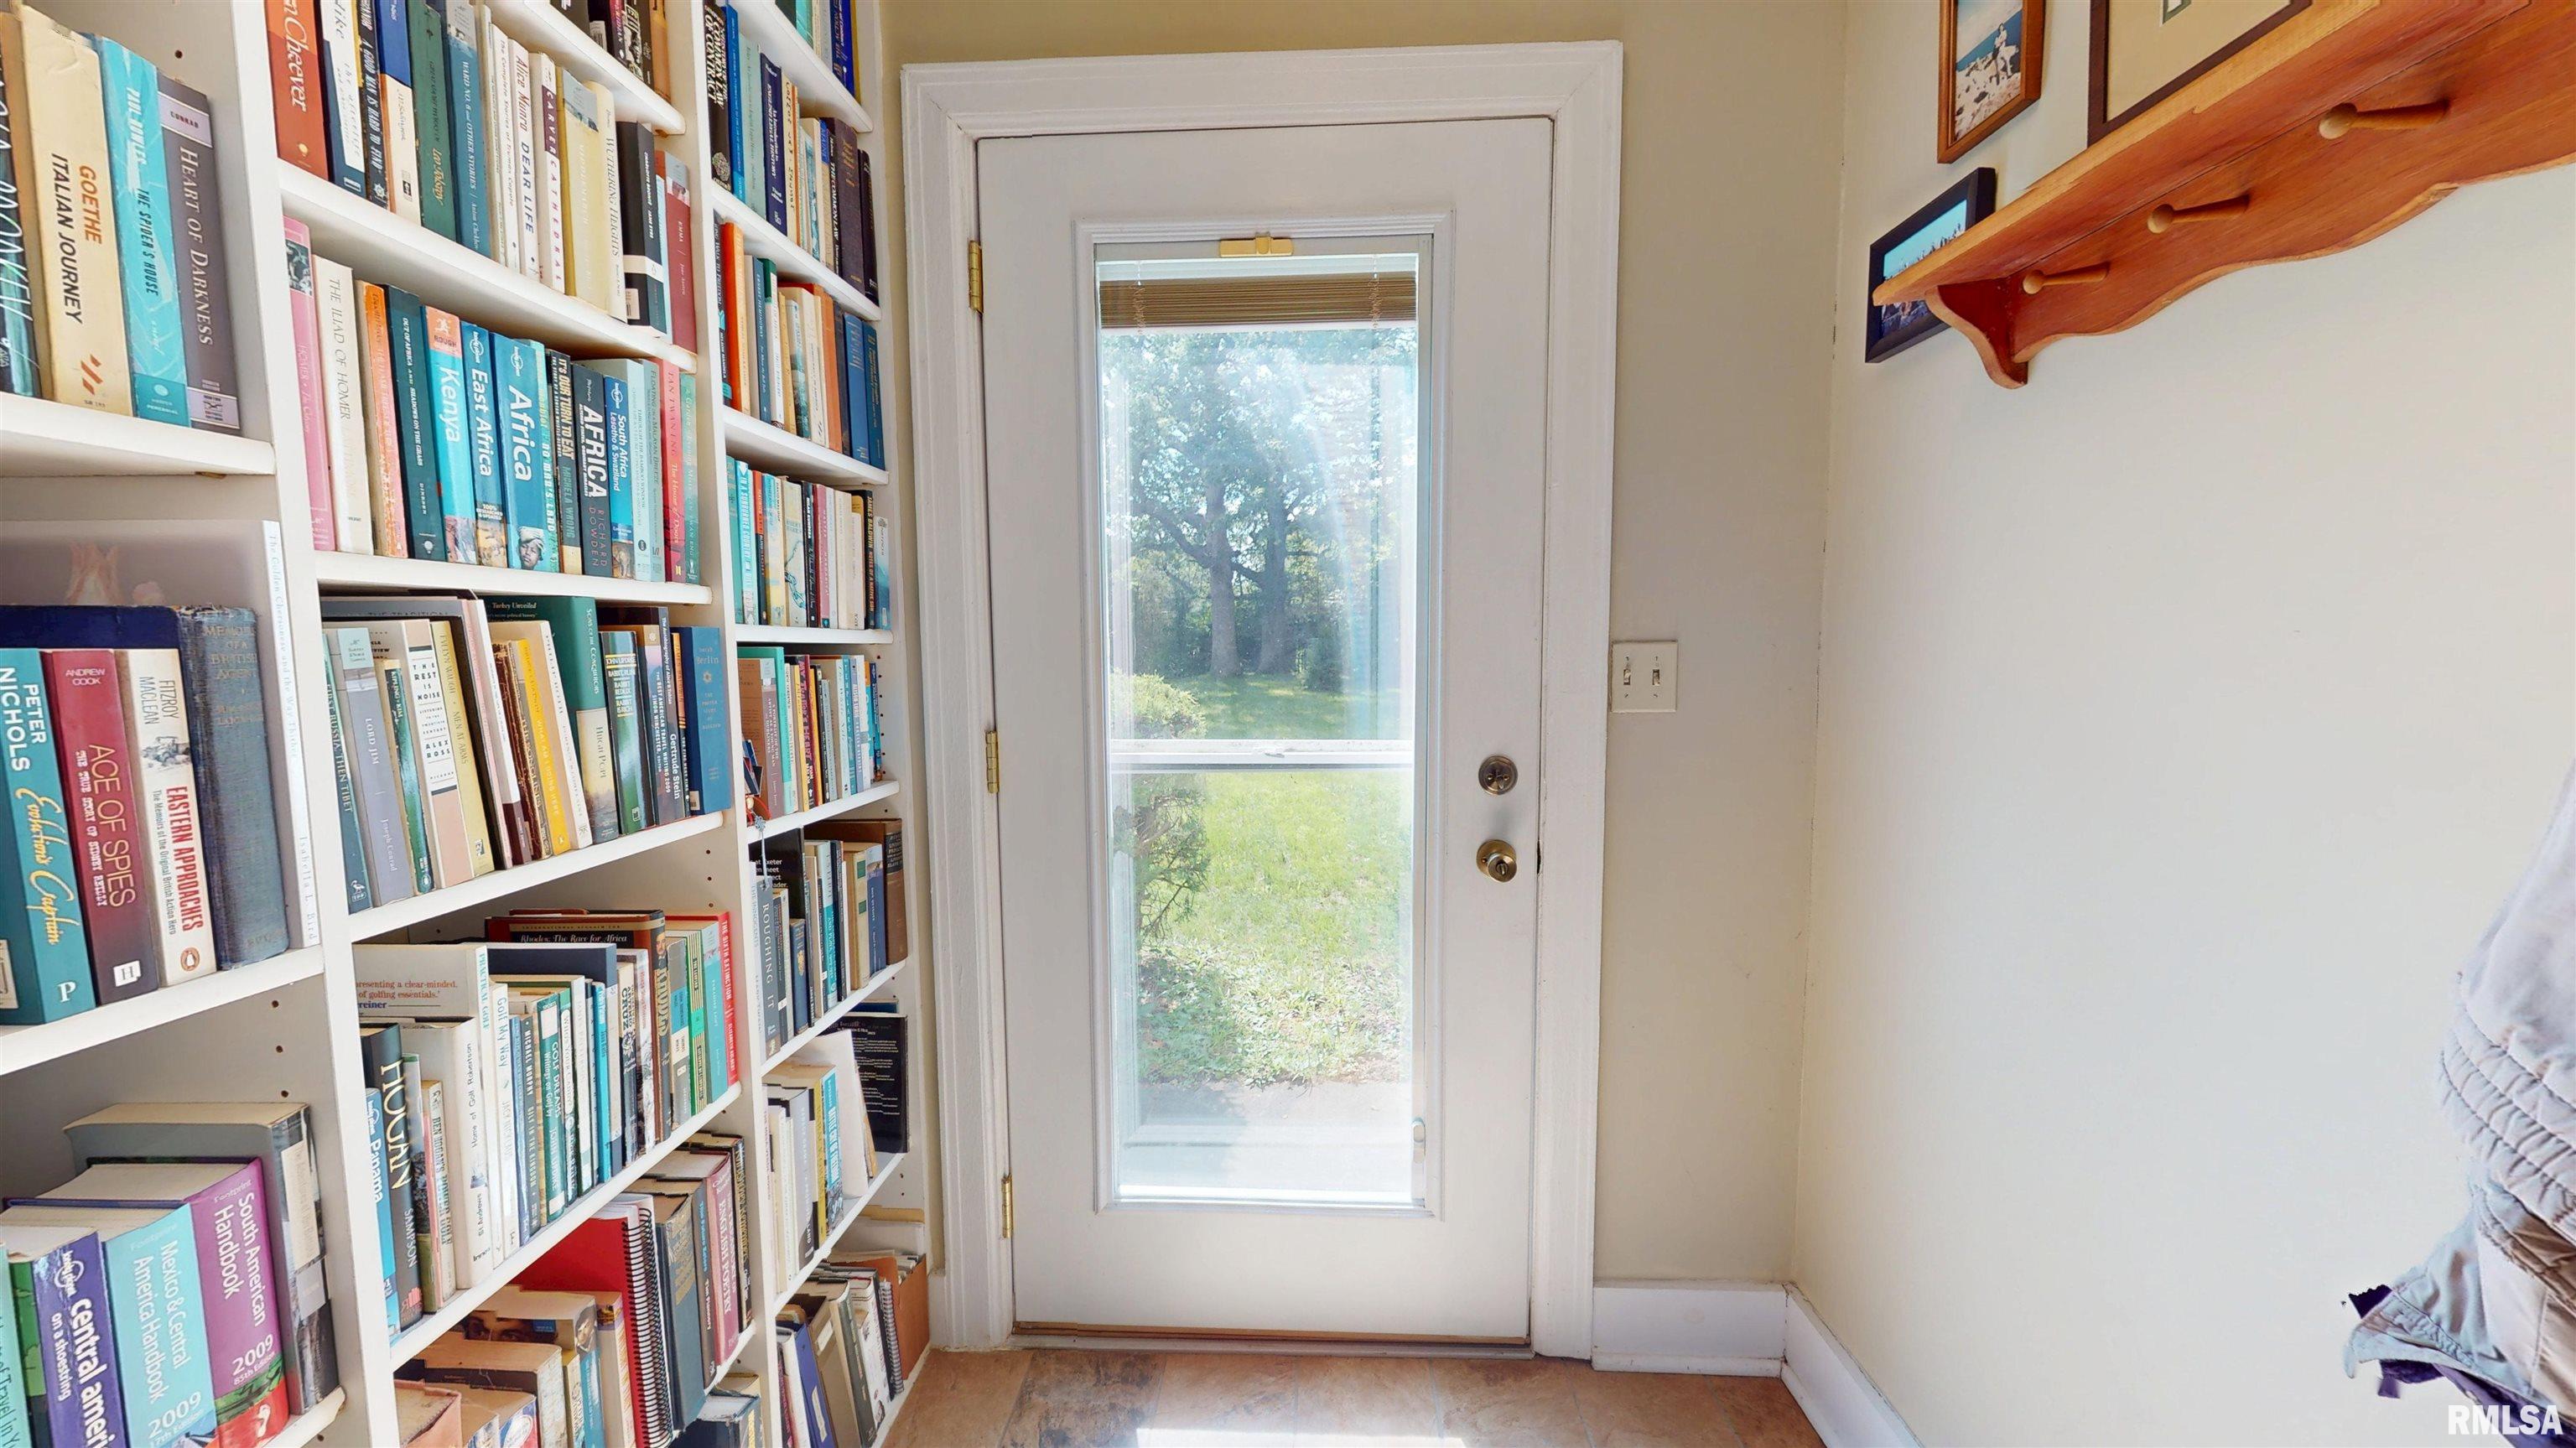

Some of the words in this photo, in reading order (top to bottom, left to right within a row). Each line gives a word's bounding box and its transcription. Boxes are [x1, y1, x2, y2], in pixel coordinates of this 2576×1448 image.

[284, 17, 309, 113] Cheever
[364, 50, 376, 74] GOOD
[517, 54, 529, 88] Alice
[365, 74, 378, 94] MAN
[170, 111, 200, 128] CONRAD
[368, 106, 381, 132] HARD
[518, 91, 530, 132] Munro
[546, 91, 557, 155] CARVER
[180, 146, 200, 213] HEART
[521, 141, 532, 189] DEAR
[606, 138, 617, 206] WUTHERING
[51, 153, 74, 228] ITALIAN
[79, 164, 102, 244] GOETHE
[138, 188, 151, 208] THE
[187, 217, 203, 243] OF
[523, 195, 534, 235] LIFE
[550, 160, 562, 280] CATHEDRAL
[610, 207, 619, 257] HEIGHTS
[59, 231, 83, 324] JOURNEY
[144, 262, 158, 296] HOUSE
[330, 279, 342, 303] THE
[190, 248, 214, 345] DARKNESS
[331, 307, 345, 344] ILIAD
[434, 335, 457, 348] ROUGH
[335, 349, 347, 369] OF
[558, 358, 568, 375] IT'S
[337, 371, 351, 420] HOMER
[472, 368, 489, 413] East
[559, 376, 571, 395] OUR
[439, 366, 460, 444] Kenya
[560, 395, 573, 423] TURN
[475, 415, 495, 478] Africa
[509, 385, 536, 481] Africa
[562, 424, 573, 436] TO
[618, 413, 628, 446] South
[562, 437, 575, 461] EAT
[582, 404, 608, 498] AFRICA
[620, 447, 629, 479] Africa
[612, 451, 621, 492] Swaziland
[589, 506, 600, 567] DOWDEN
[597, 509, 608, 567] RICHARD
[439, 635, 450, 665] EVELYN
[65, 668, 106, 677] ANDREW
[72, 677, 101, 687] COOK
[414, 672, 437, 681] REST
[139, 676, 158, 725] MACLEAN
[159, 679, 179, 719] FITZROY
[418, 692, 441, 701] NOISE
[0, 667, 30, 772] NICHOLS
[23, 683, 47, 745] PETER
[365, 717, 377, 745] LORD
[75, 750, 87, 768] THE
[369, 749, 380, 765] JIM
[425, 740, 449, 750] ALEX
[427, 749, 451, 759] ROSS
[670, 734, 680, 775] Gertrude
[79, 771, 91, 794] TRUE
[89, 744, 122, 796] ACE
[153, 789, 161, 802] The
[341, 781, 353, 812] TIBET
[673, 776, 681, 800] Stein
[81, 797, 97, 823] STORY
[97, 800, 127, 833] OF
[154, 803, 164, 829] Memoirs
[165, 785, 194, 844] EASTERN
[86, 826, 98, 838] OF
[381, 817, 392, 845] Joseph
[87, 840, 104, 873] SIDNEY
[102, 838, 137, 909] SPIES
[160, 850, 170, 877] Original
[384, 845, 397, 872] Conrad
[92, 874, 108, 908] REILLY
[163, 877, 173, 897] British
[174, 846, 204, 932] APPROACHES
[166, 898, 175, 919] Action
[169, 920, 178, 935] Hero
[762, 902, 773, 984] ROUGHING
[358, 990, 367, 999] of
[369, 990, 396, 1000] golfing
[724, 958, 733, 1001] EXTINCTION
[497, 998, 508, 1024] Golf
[767, 994, 775, 1008] IT
[497, 1025, 509, 1041] My
[524, 1030, 532, 1063] MICHAEL
[498, 1046, 511, 1067] Way
[552, 1041, 560, 1071] GOLF
[526, 1065, 535, 1096] MURPHY
[553, 1074, 562, 1118] DREAMS
[381, 1059, 413, 1190] HOGAN
[370, 1138, 384, 1203] Panama
[238, 1191, 256, 1247] South
[719, 1199, 729, 1256] ENGLISH
[214, 1204, 245, 1300] Handbook
[404, 1207, 418, 1269] SAMPSON
[161, 1239, 180, 1303] Mexico
[246, 1244, 267, 1328] American
[722, 1257, 732, 1316] POETRY
[133, 1256, 155, 1322] America
[51, 1312, 63, 1330] on
[167, 1300, 184, 1314] &
[70, 1298, 107, 1385] central
[168, 1311, 191, 1370] Central
[231, 1333, 275, 1376] 2009
[55, 1338, 72, 1403] shoestring
[141, 1319, 169, 1404] Handbook
[233, 1368, 254, 1386] 85th
[148, 1390, 202, 1439] 2009
